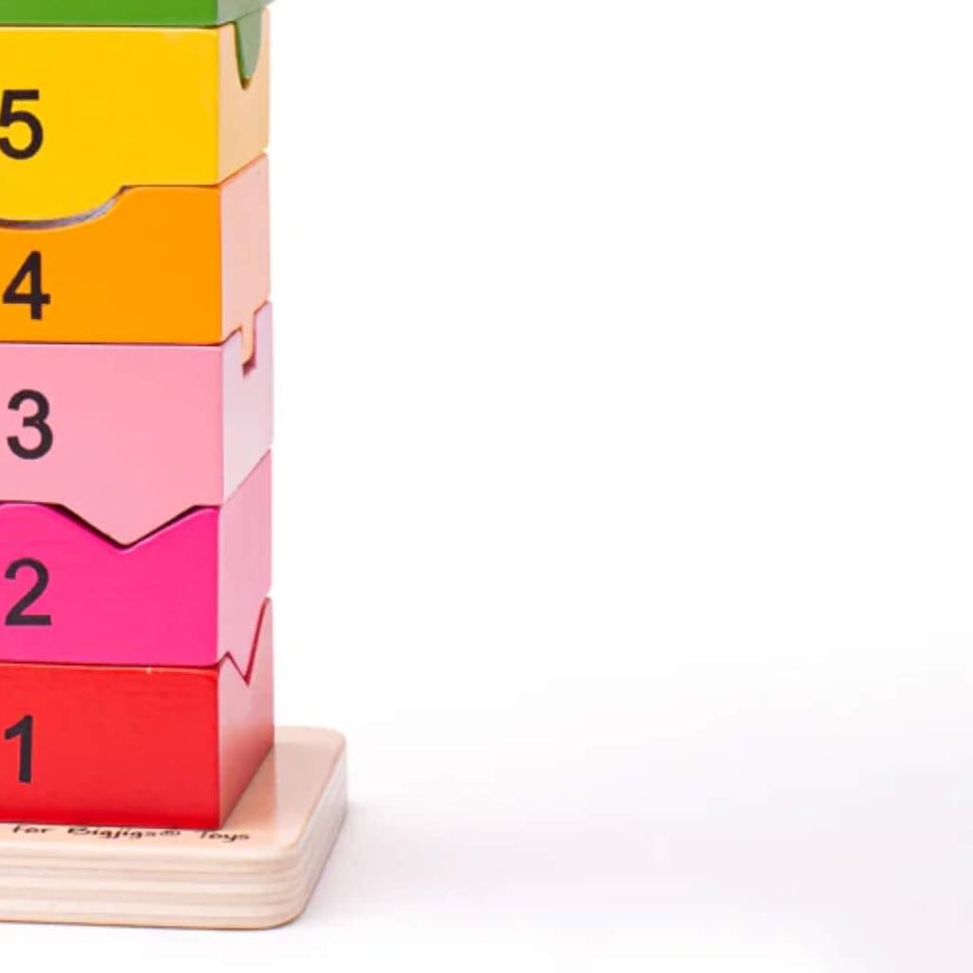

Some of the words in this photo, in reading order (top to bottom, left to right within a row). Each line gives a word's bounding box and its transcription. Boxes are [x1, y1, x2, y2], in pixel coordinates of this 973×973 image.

[2, 251, 51, 320] 4
[7, 389, 53, 460] 3
[4, 557, 53, 627] 2
[3, 714, 34, 784] 1
[199, 830, 251, 843] Toys
